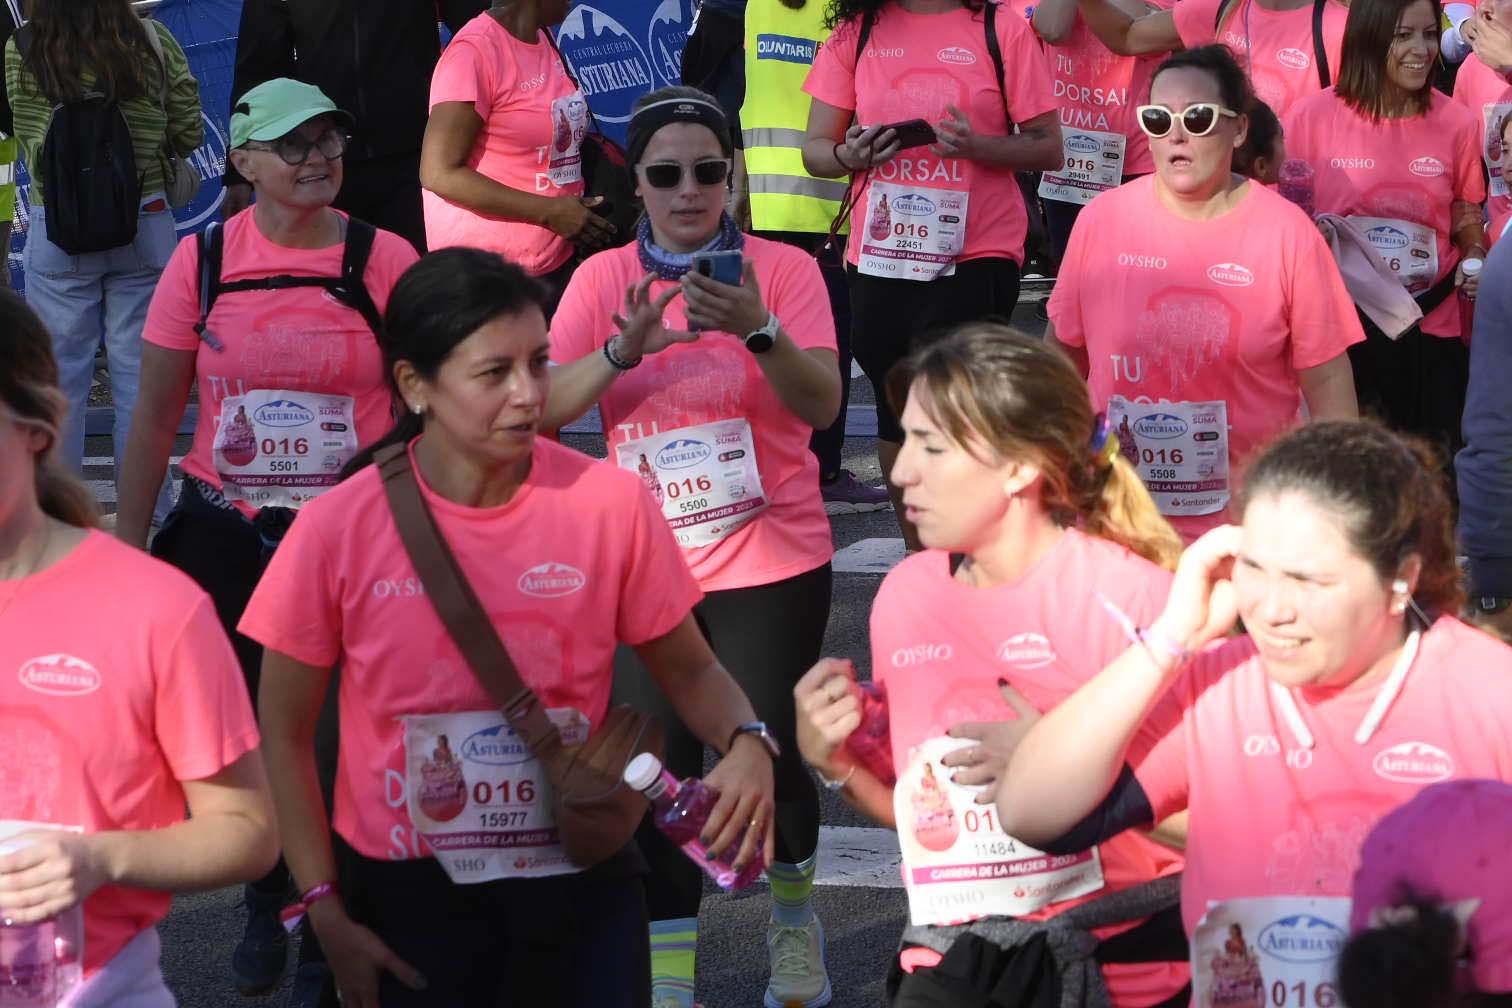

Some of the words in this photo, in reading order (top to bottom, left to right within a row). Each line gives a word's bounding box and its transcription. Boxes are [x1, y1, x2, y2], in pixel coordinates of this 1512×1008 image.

[667, 30, 689, 44] CENT
[573, 45, 601, 60] CENTRAL
[1056, 54, 1072, 75] TU
[1060, 107, 1110, 130] UMA
[1067, 157, 1095, 171] 016
[1330, 157, 1375, 169] OYSHO
[894, 222, 929, 238] 016
[896, 239, 923, 250] 22451
[867, 261, 896, 272] OYSHO
[1118, 252, 1167, 270] OYSHO
[1110, 354, 1142, 383] TU
[1137, 422, 1187, 433] ASTURIANA
[261, 437, 309, 455] 016
[1142, 448, 1184, 464] 016
[269, 460, 299, 472] 5501
[1150, 469, 1176, 479] 5508
[667, 474, 712, 499] 016
[1172, 483, 1198, 491] MUJER
[679, 497, 708, 513] 5500
[707, 506, 734, 521] MUJER
[523, 574, 580, 588] ASTURIANA
[467, 740, 528, 757] ASTURIA
[472, 779, 535, 804] 016
[479, 811, 528, 828] 15977
[965, 808, 996, 833] 01
[974, 839, 1016, 856] 11484
[453, 857, 486, 872] SHO
[930, 867, 977, 881] CARRERA
[978, 866, 992, 878] DE
[994, 865, 1008, 877] LA
[1009, 859, 1048, 875] MUJER
[1271, 980, 1337, 1008] 016
